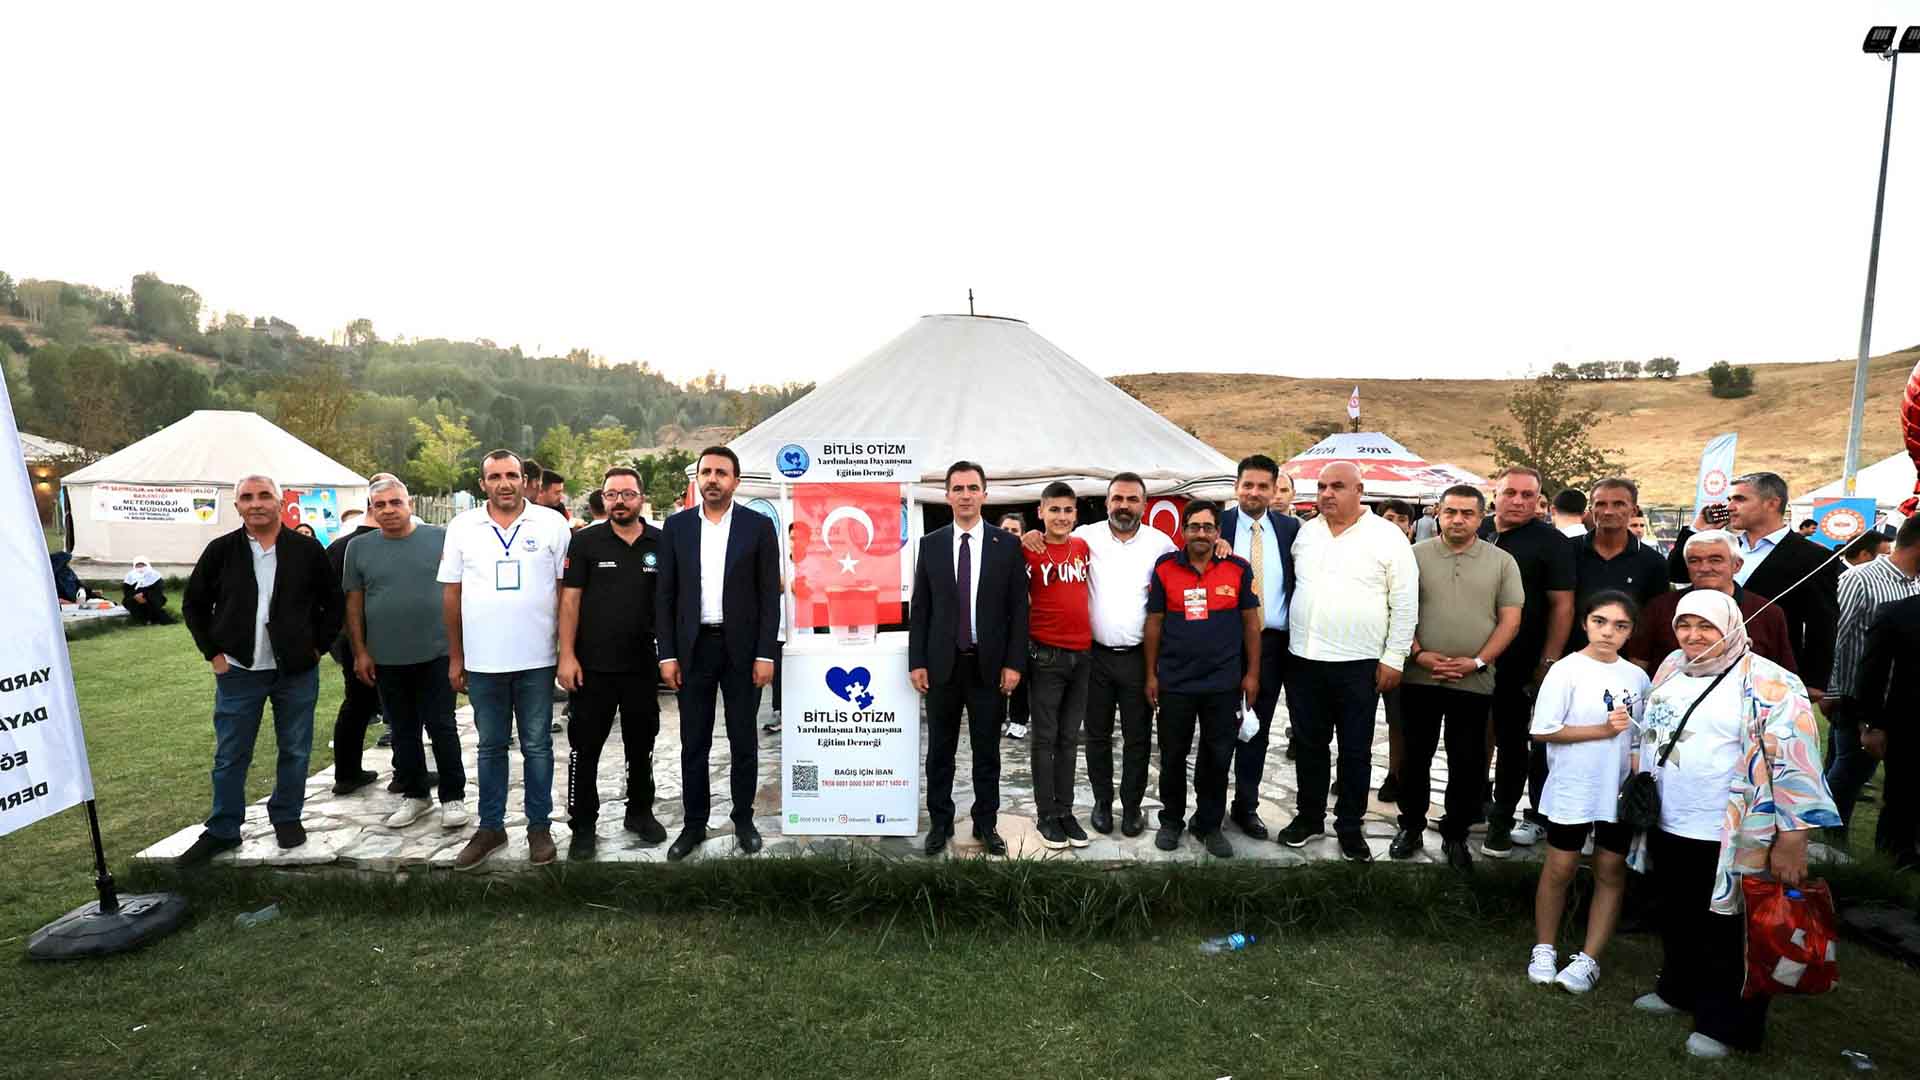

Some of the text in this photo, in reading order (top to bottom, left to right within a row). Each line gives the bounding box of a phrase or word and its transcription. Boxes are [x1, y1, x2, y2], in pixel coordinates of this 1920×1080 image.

[823, 442, 906, 455] BİTLİS OTİZM
[817, 457, 912, 466] Yardımlaşma Dayanışma
[836, 469, 894, 477] Eğitim Derneği
[804, 709, 895, 723] BİTLİS OTİZM
[797, 725, 902, 735] Yardımlaşma Dayanışma
[817, 738, 881, 747] Eğitim Derneği
[834, 768, 857, 777] BAĞIŞ
[859, 768, 874, 777] İÇİN
